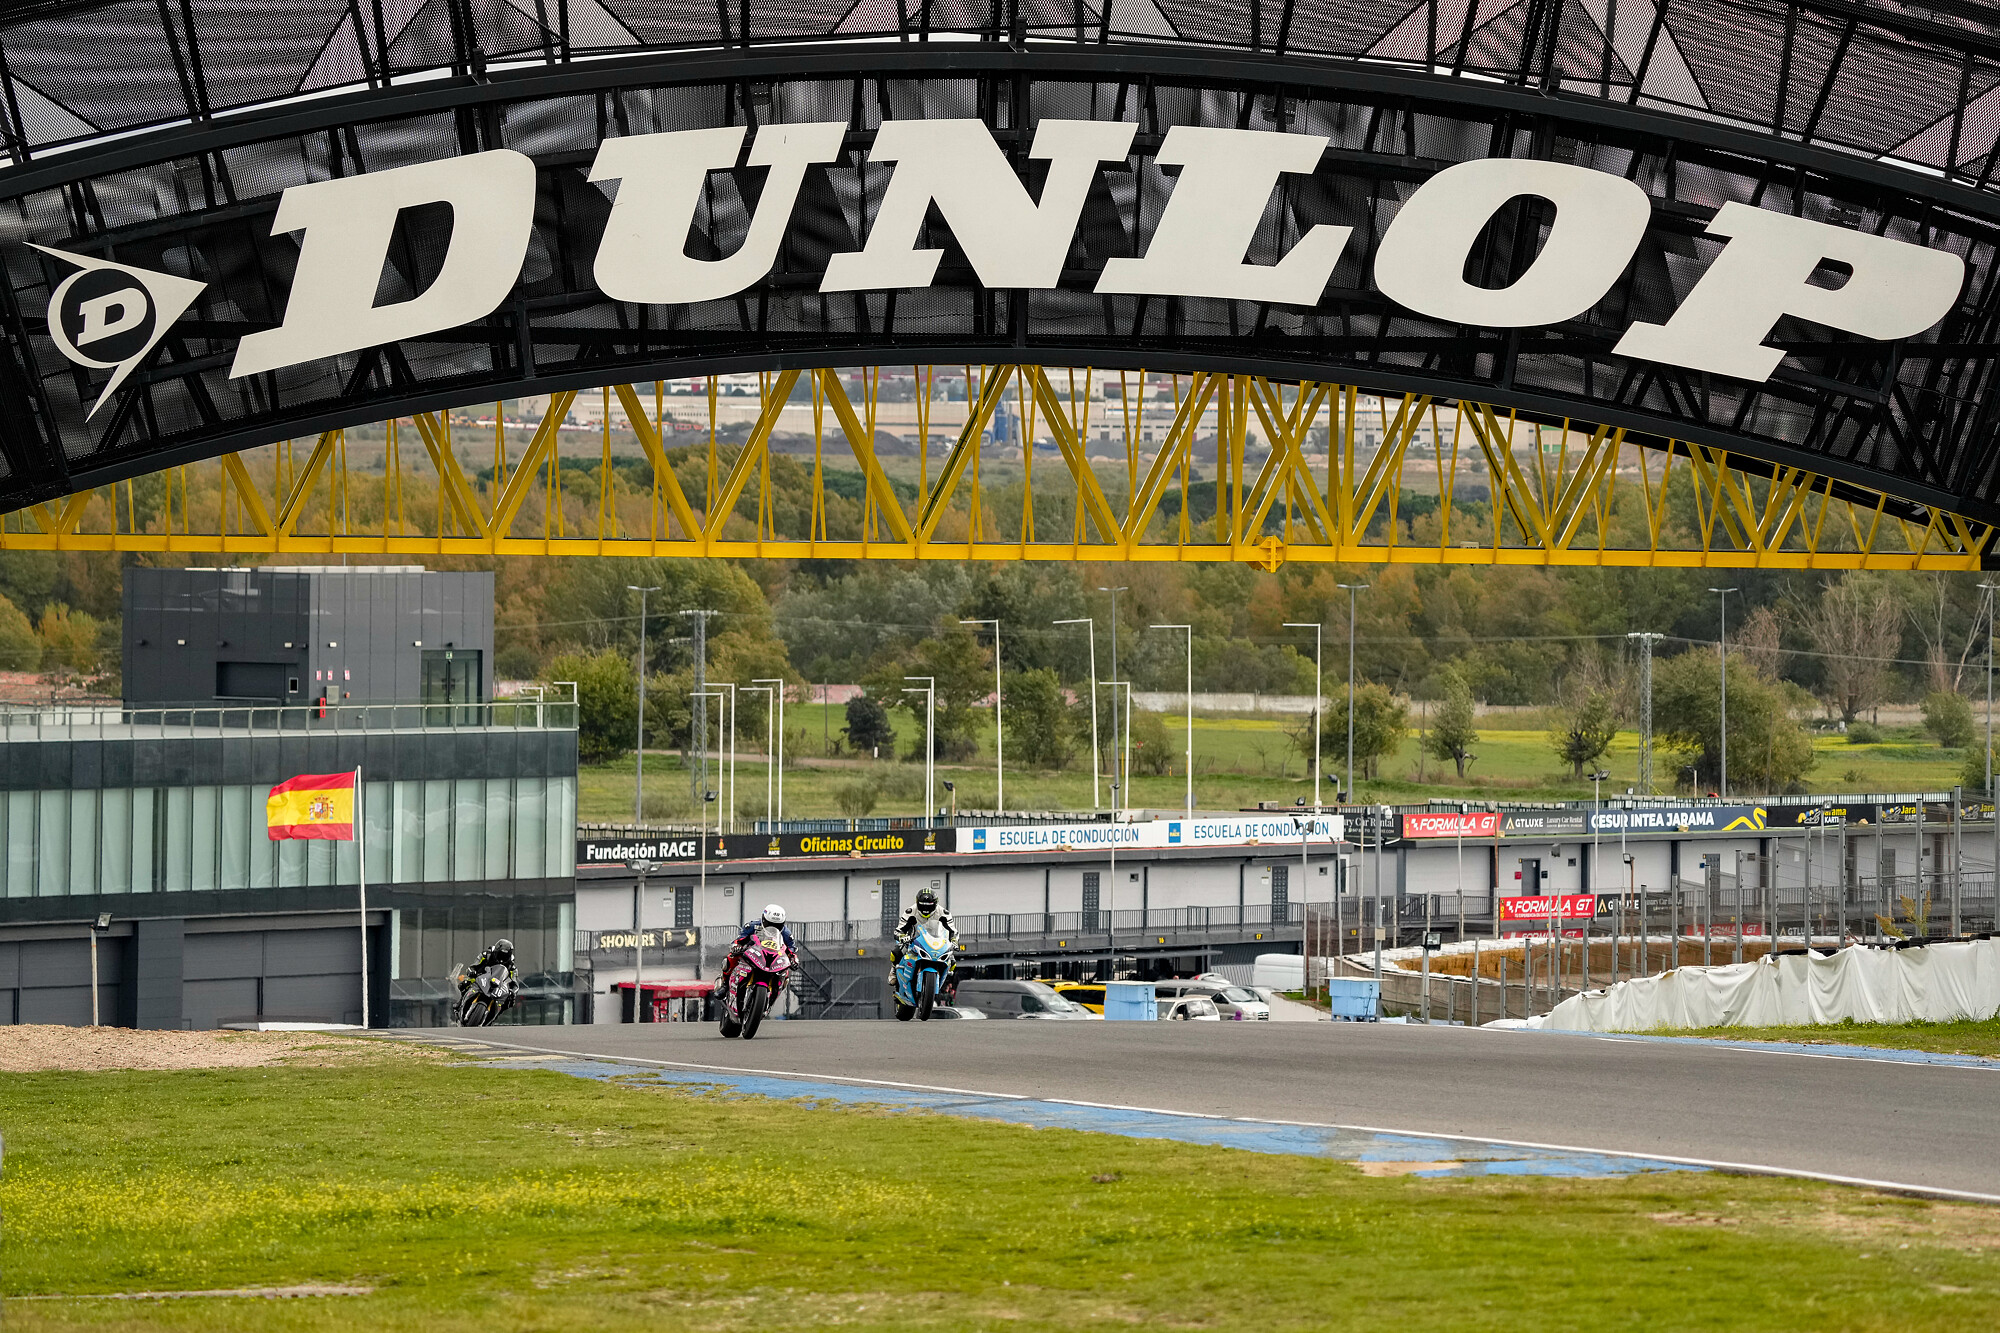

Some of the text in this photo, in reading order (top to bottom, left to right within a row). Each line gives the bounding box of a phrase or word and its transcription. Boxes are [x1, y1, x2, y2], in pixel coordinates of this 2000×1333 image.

[229, 118, 1965, 383] DUNLOP
[1823, 808, 1846, 816] arama
[1900, 805, 1926, 814] Jaraa
[1980, 803, 1995, 812] Jara
[1370, 817, 1394, 828] Rntal
[1419, 816, 1498, 831] FORMULA GT
[1515, 818, 1543, 828] GTLUXE
[1591, 811, 1714, 829] CESUR INTEA JARAMA
[1194, 818, 1329, 839] ESCUELA DE CONDUCCÓN
[800, 834, 904, 853] Oficinas Circuito
[999, 830, 1049, 846] ESCUELA
[1052, 829, 1066, 844] DE
[586, 841, 696, 860] Fundación RACE
[1515, 898, 1593, 913] FORMUA GT
[1787, 926, 1814, 935] GTLUE
